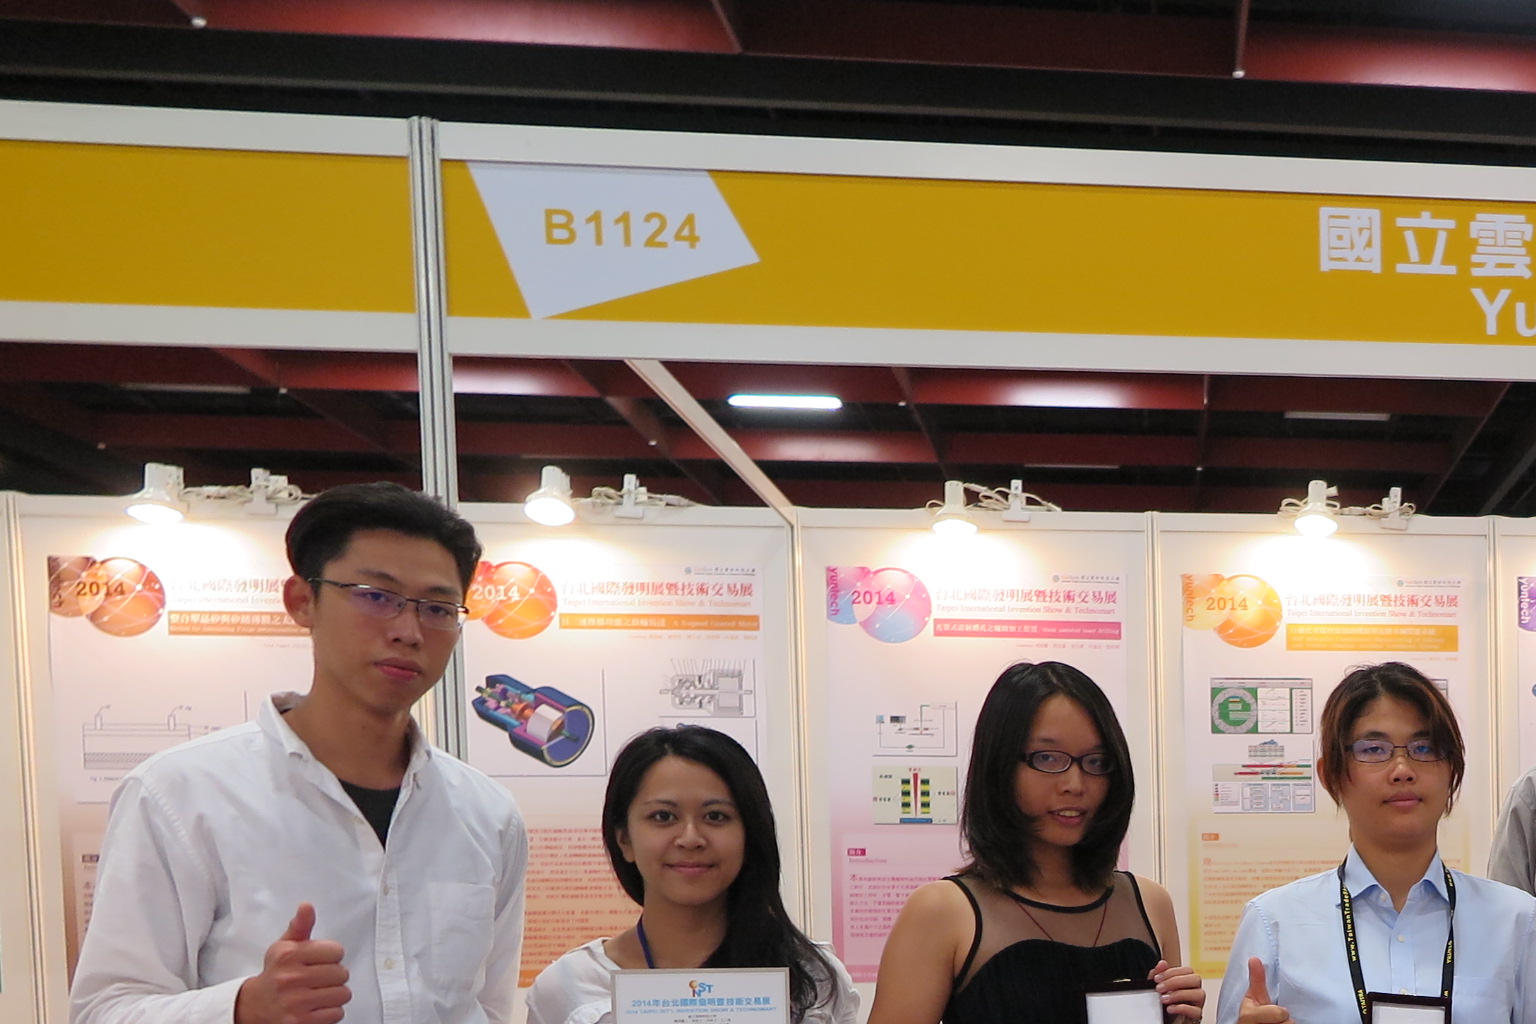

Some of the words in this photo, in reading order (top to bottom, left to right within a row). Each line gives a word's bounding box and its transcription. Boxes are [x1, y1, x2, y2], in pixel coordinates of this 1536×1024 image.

[544, 208, 701, 249] B1124
[75, 581, 126, 597] 2014
[472, 584, 520, 600] 2014
[828, 567, 840, 616] yuntech
[852, 590, 896, 605] 2014
[1184, 574, 1194, 622] yuntech
[1519, 578, 1531, 624] yuntech
[1206, 597, 1249, 612] 2014
